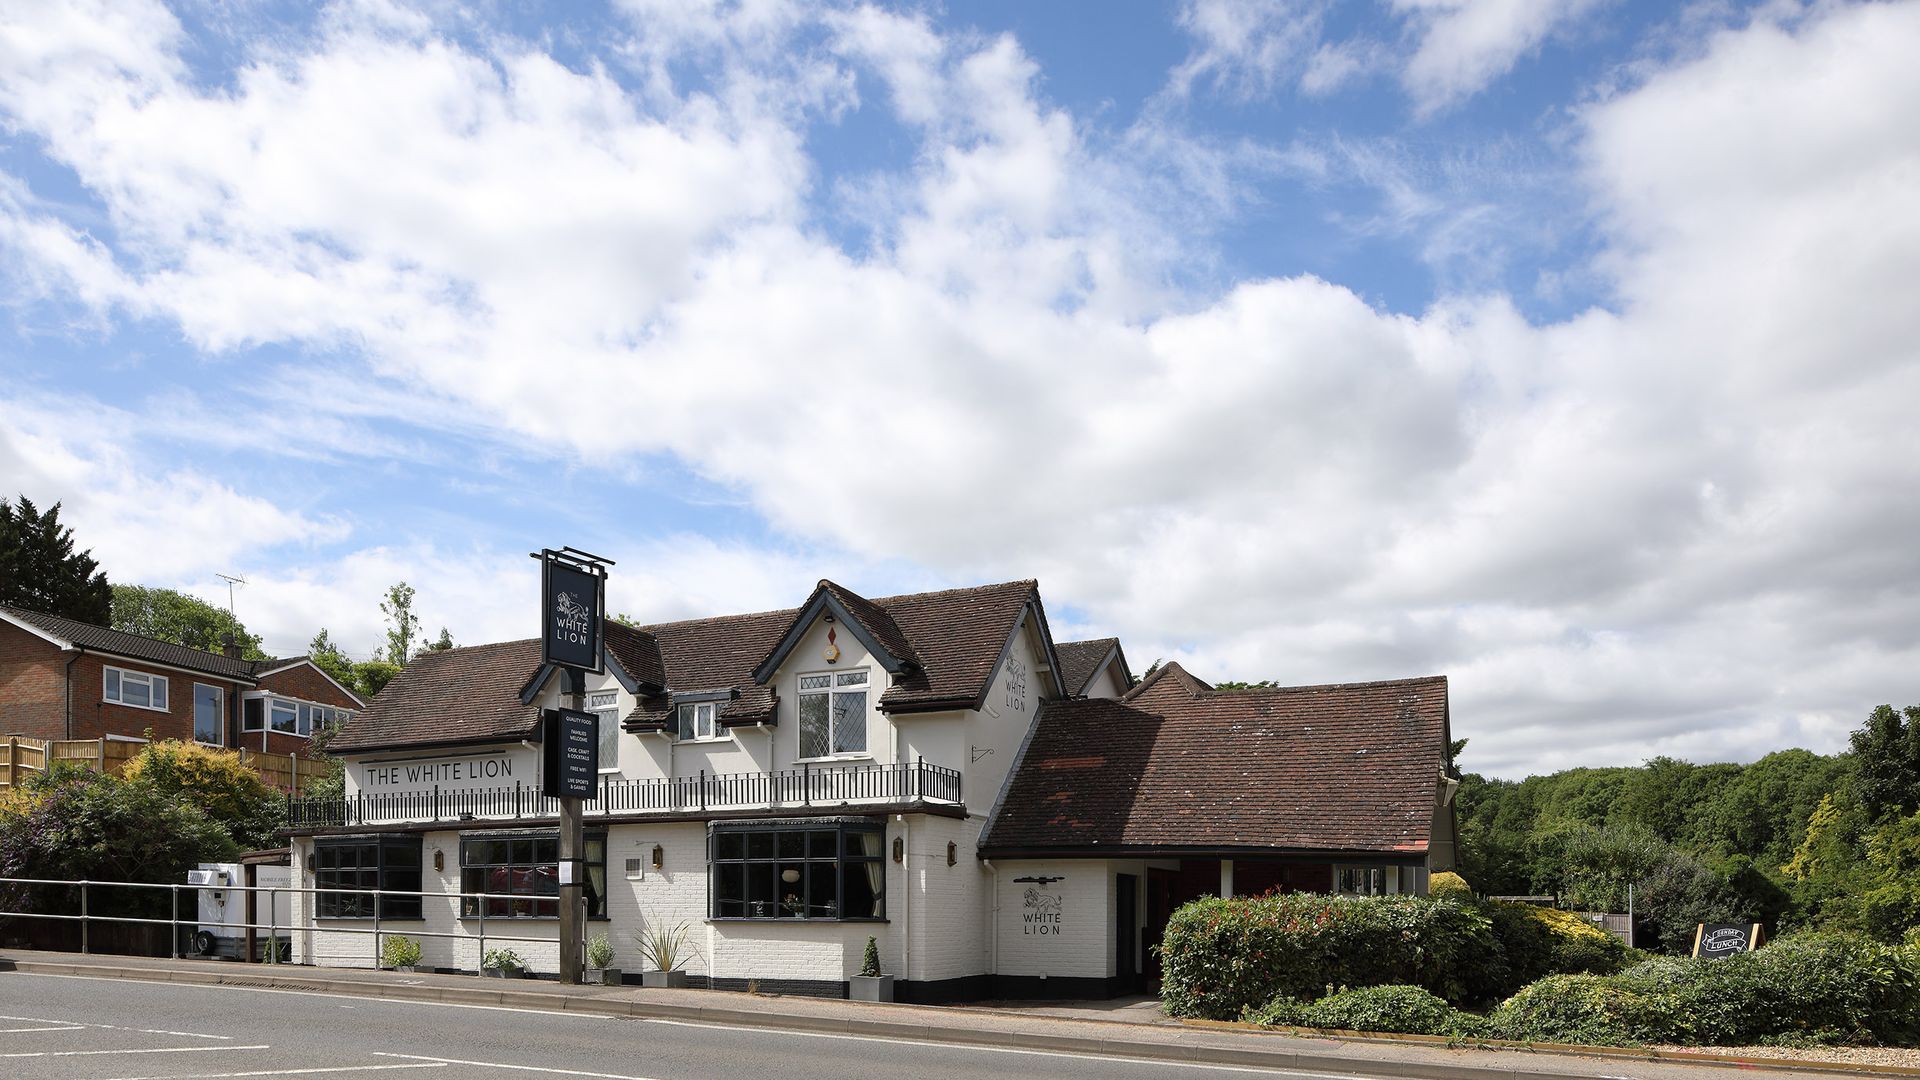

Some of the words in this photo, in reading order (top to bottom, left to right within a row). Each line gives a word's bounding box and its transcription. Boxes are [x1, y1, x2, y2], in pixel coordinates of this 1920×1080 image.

[556, 617, 588, 634] WHITE
[557, 629, 586, 645] LION
[1005, 680, 1026, 698] WHITE
[1006, 694, 1025, 712] LION
[565, 715, 581, 723] QUALITY
[570, 729, 587, 737] FAMILIES
[570, 735, 588, 743] WELCOME
[571, 753, 590, 761] COCKTAILS
[367, 767, 399, 785] THE
[406, 763, 461, 783] WHITE
[470, 759, 512, 779] LION
[1023, 913, 1061, 923] WHITE
[1024, 925, 1060, 935] LION
[1711, 940, 1738, 949] LUNCH
